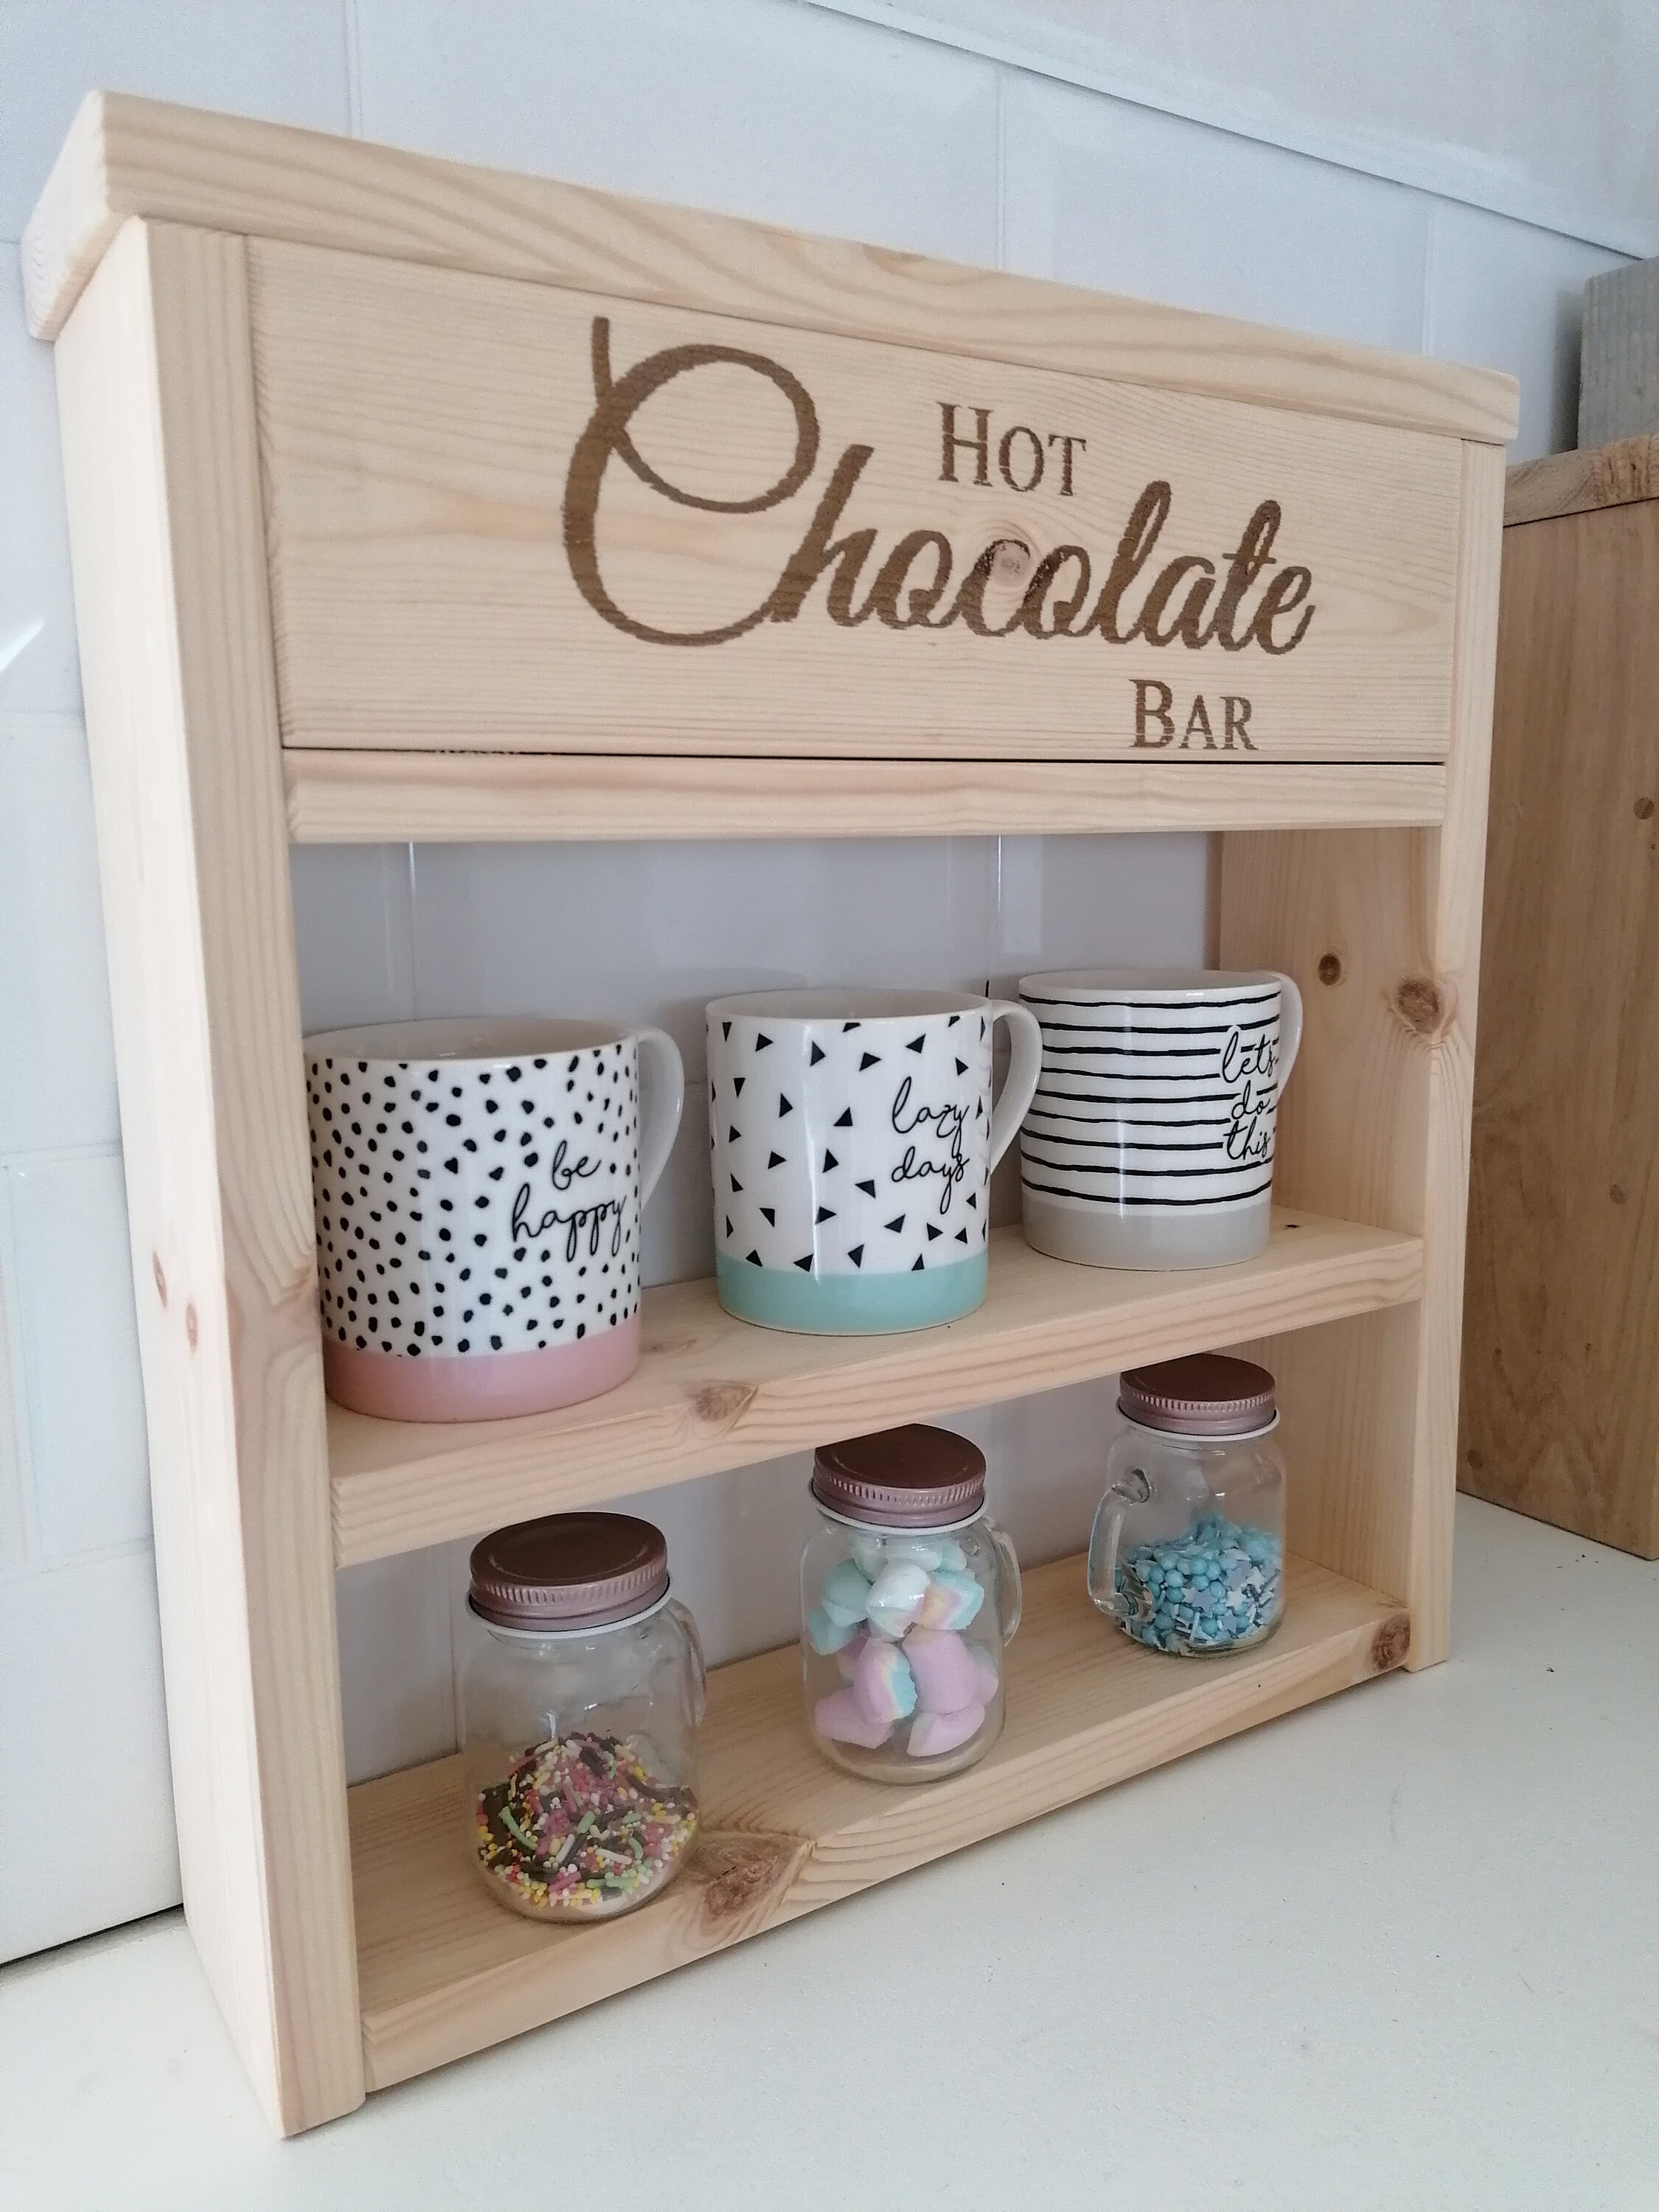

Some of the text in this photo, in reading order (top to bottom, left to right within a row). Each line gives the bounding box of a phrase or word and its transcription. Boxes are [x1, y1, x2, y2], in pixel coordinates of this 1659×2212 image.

[937, 402, 1086, 496] HOT
[563, 317, 1315, 655] Chocolate
[1130, 679, 1259, 750] BAR
[891, 1076, 970, 1158] lazy
[1231, 1079, 1270, 1120] do
[552, 1141, 601, 1189] be
[1223, 1116, 1271, 1160] this
[891, 1146, 970, 1214] days
[512, 1183, 626, 1262] happy
